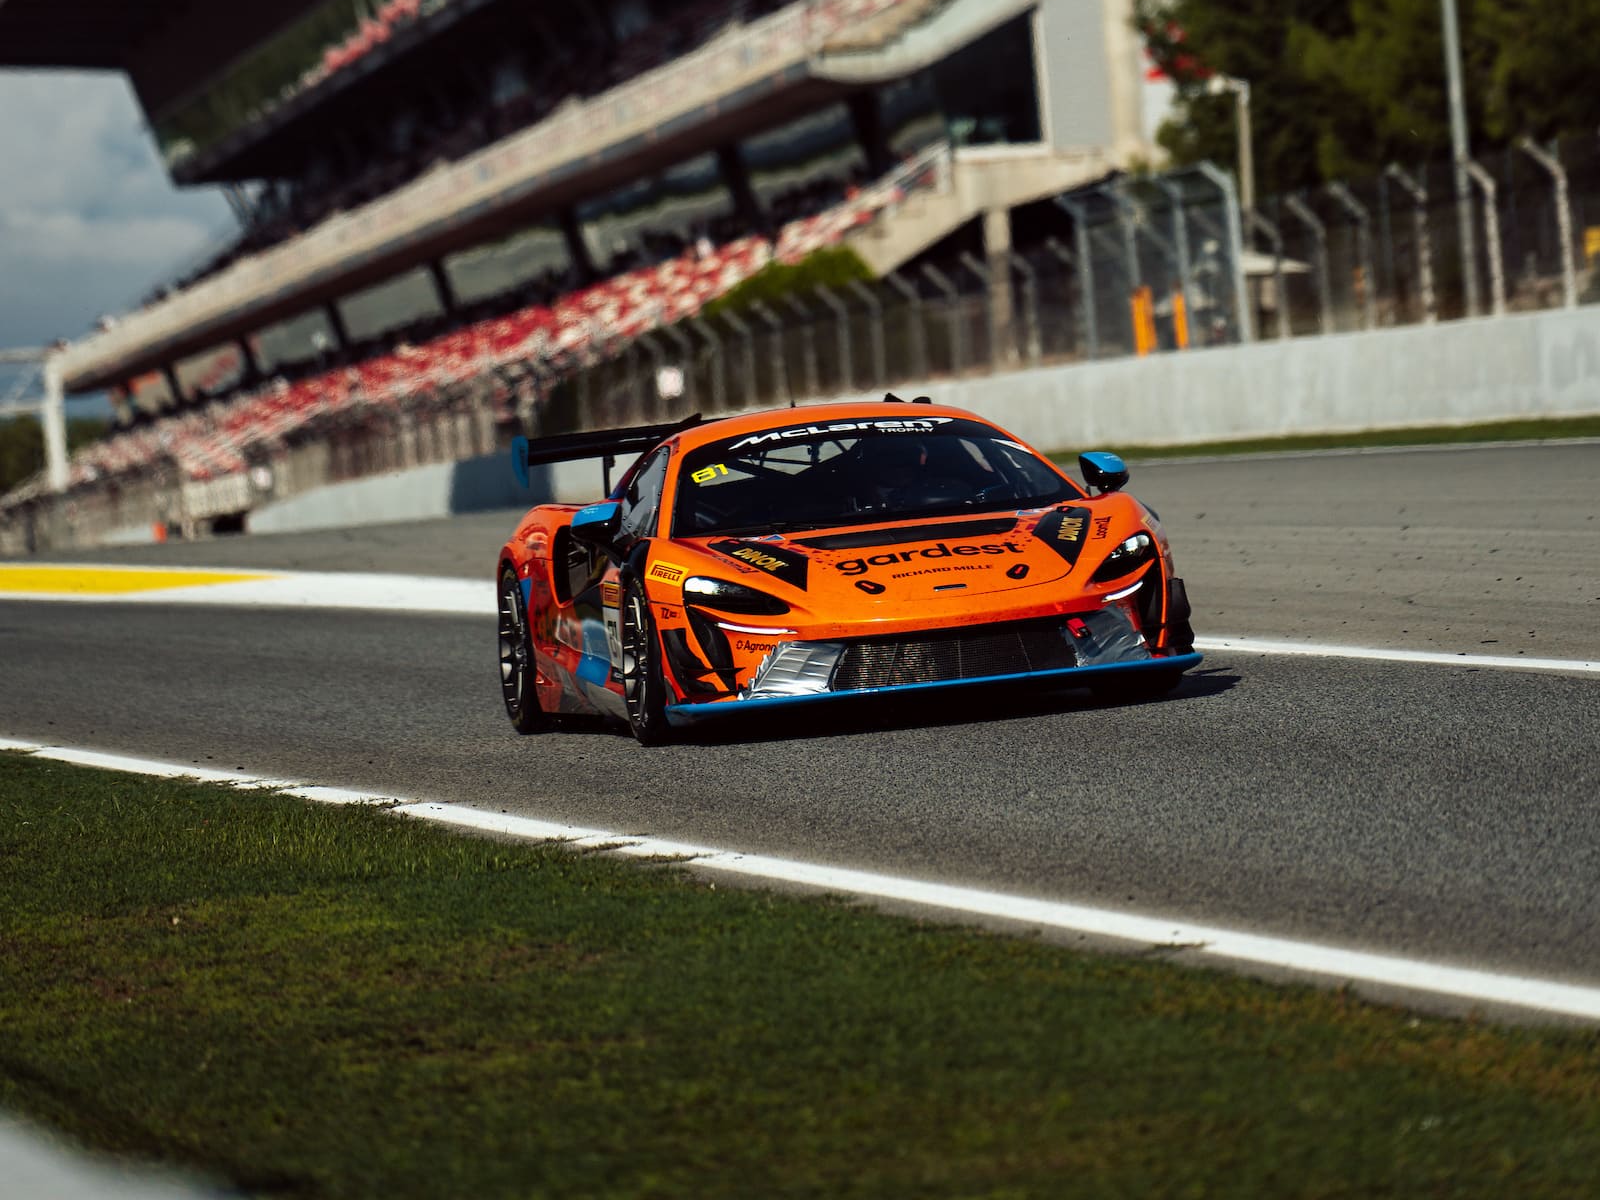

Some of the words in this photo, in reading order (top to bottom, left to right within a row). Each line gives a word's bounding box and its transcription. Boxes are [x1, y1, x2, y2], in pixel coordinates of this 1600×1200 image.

[728, 417, 937, 450] McLaren
[691, 463, 729, 483] 81
[835, 542, 1024, 576] gardest
[650, 564, 683, 582] PIRELLI
[892, 566, 952, 579] RICHARD
[953, 564, 993, 572] MILLE
